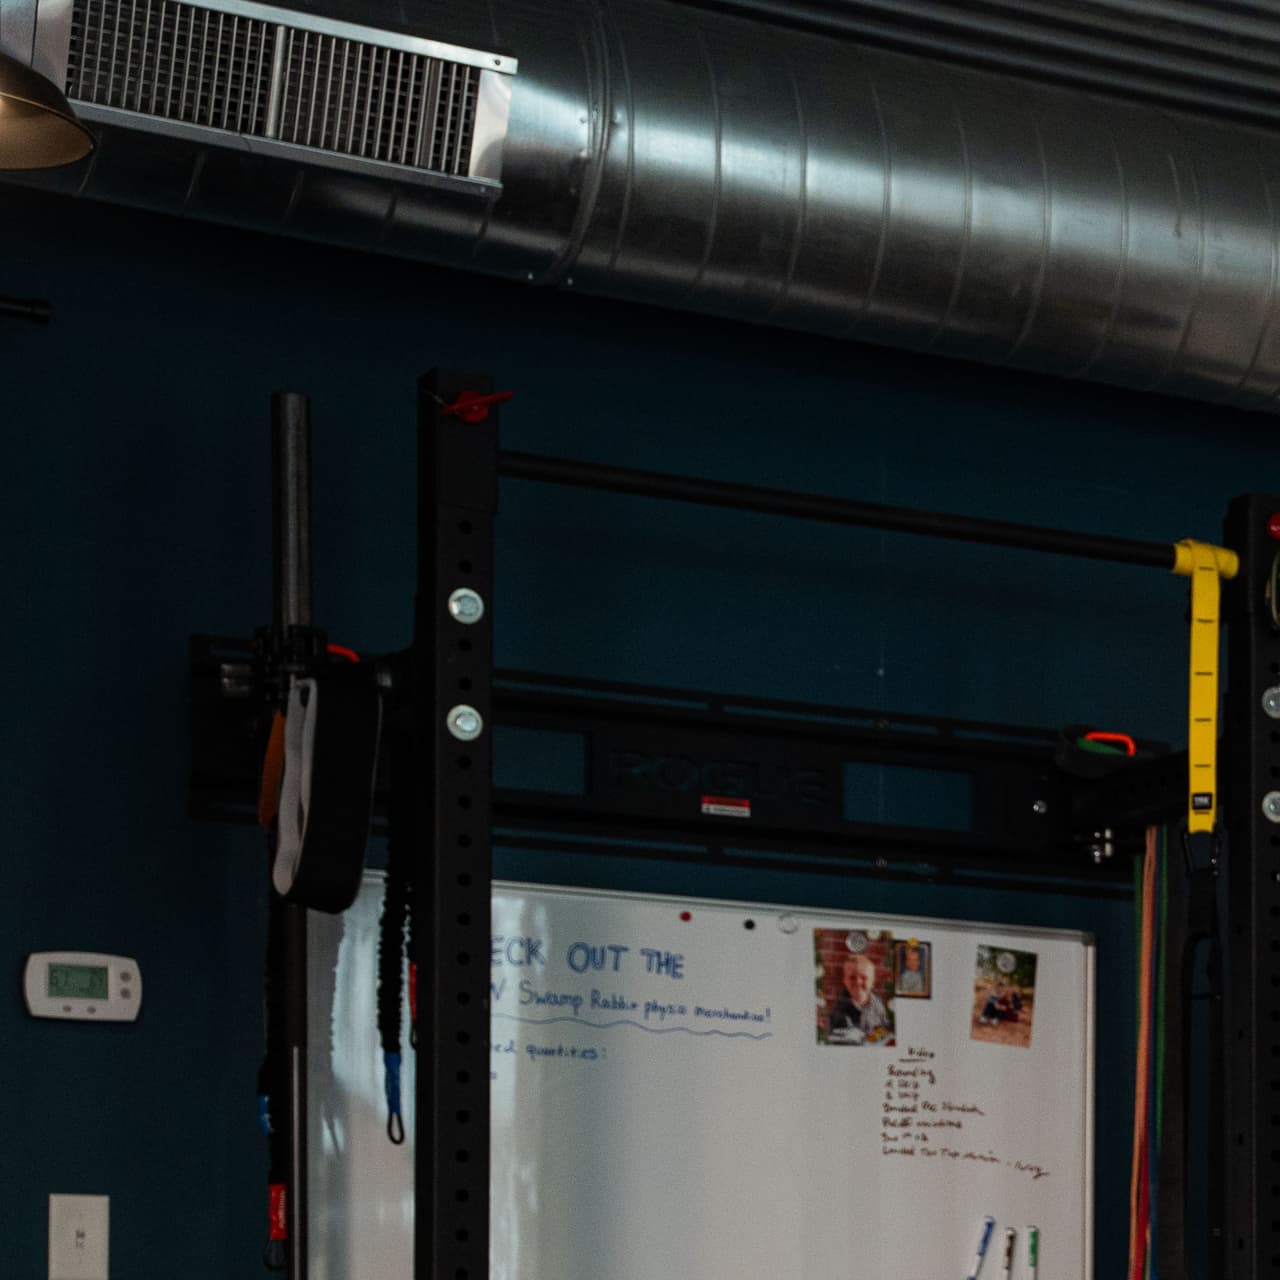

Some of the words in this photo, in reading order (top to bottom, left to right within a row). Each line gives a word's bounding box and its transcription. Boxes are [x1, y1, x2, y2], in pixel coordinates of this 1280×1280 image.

[490, 934, 546, 967] ECK
[566, 940, 629, 974] OUT
[640, 947, 686, 980] THE
